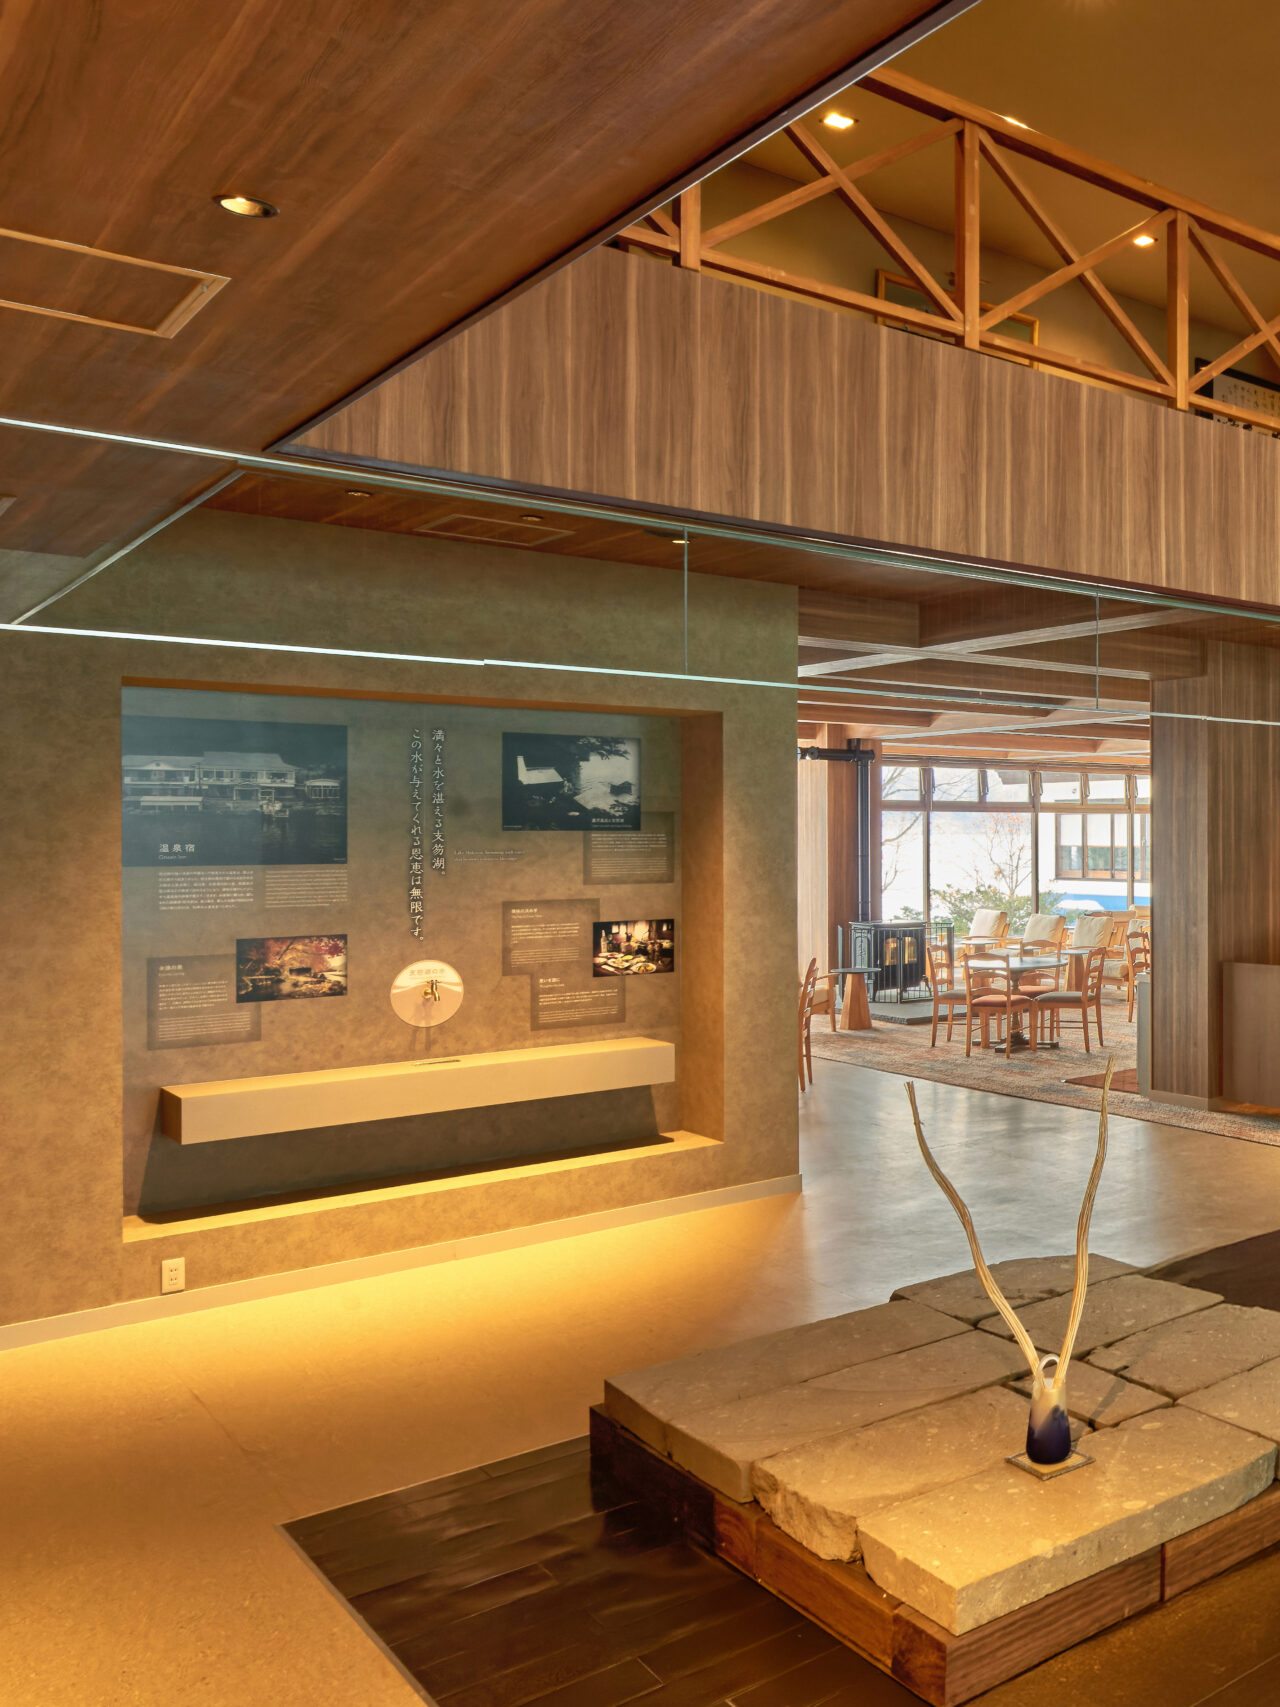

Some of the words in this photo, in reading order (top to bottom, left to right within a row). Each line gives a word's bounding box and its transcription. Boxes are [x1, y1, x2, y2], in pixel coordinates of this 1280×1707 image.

[159, 843, 195, 853] 温泉宿
[409, 728, 424, 940] この水が与えてくれる恩恵は無限です。
